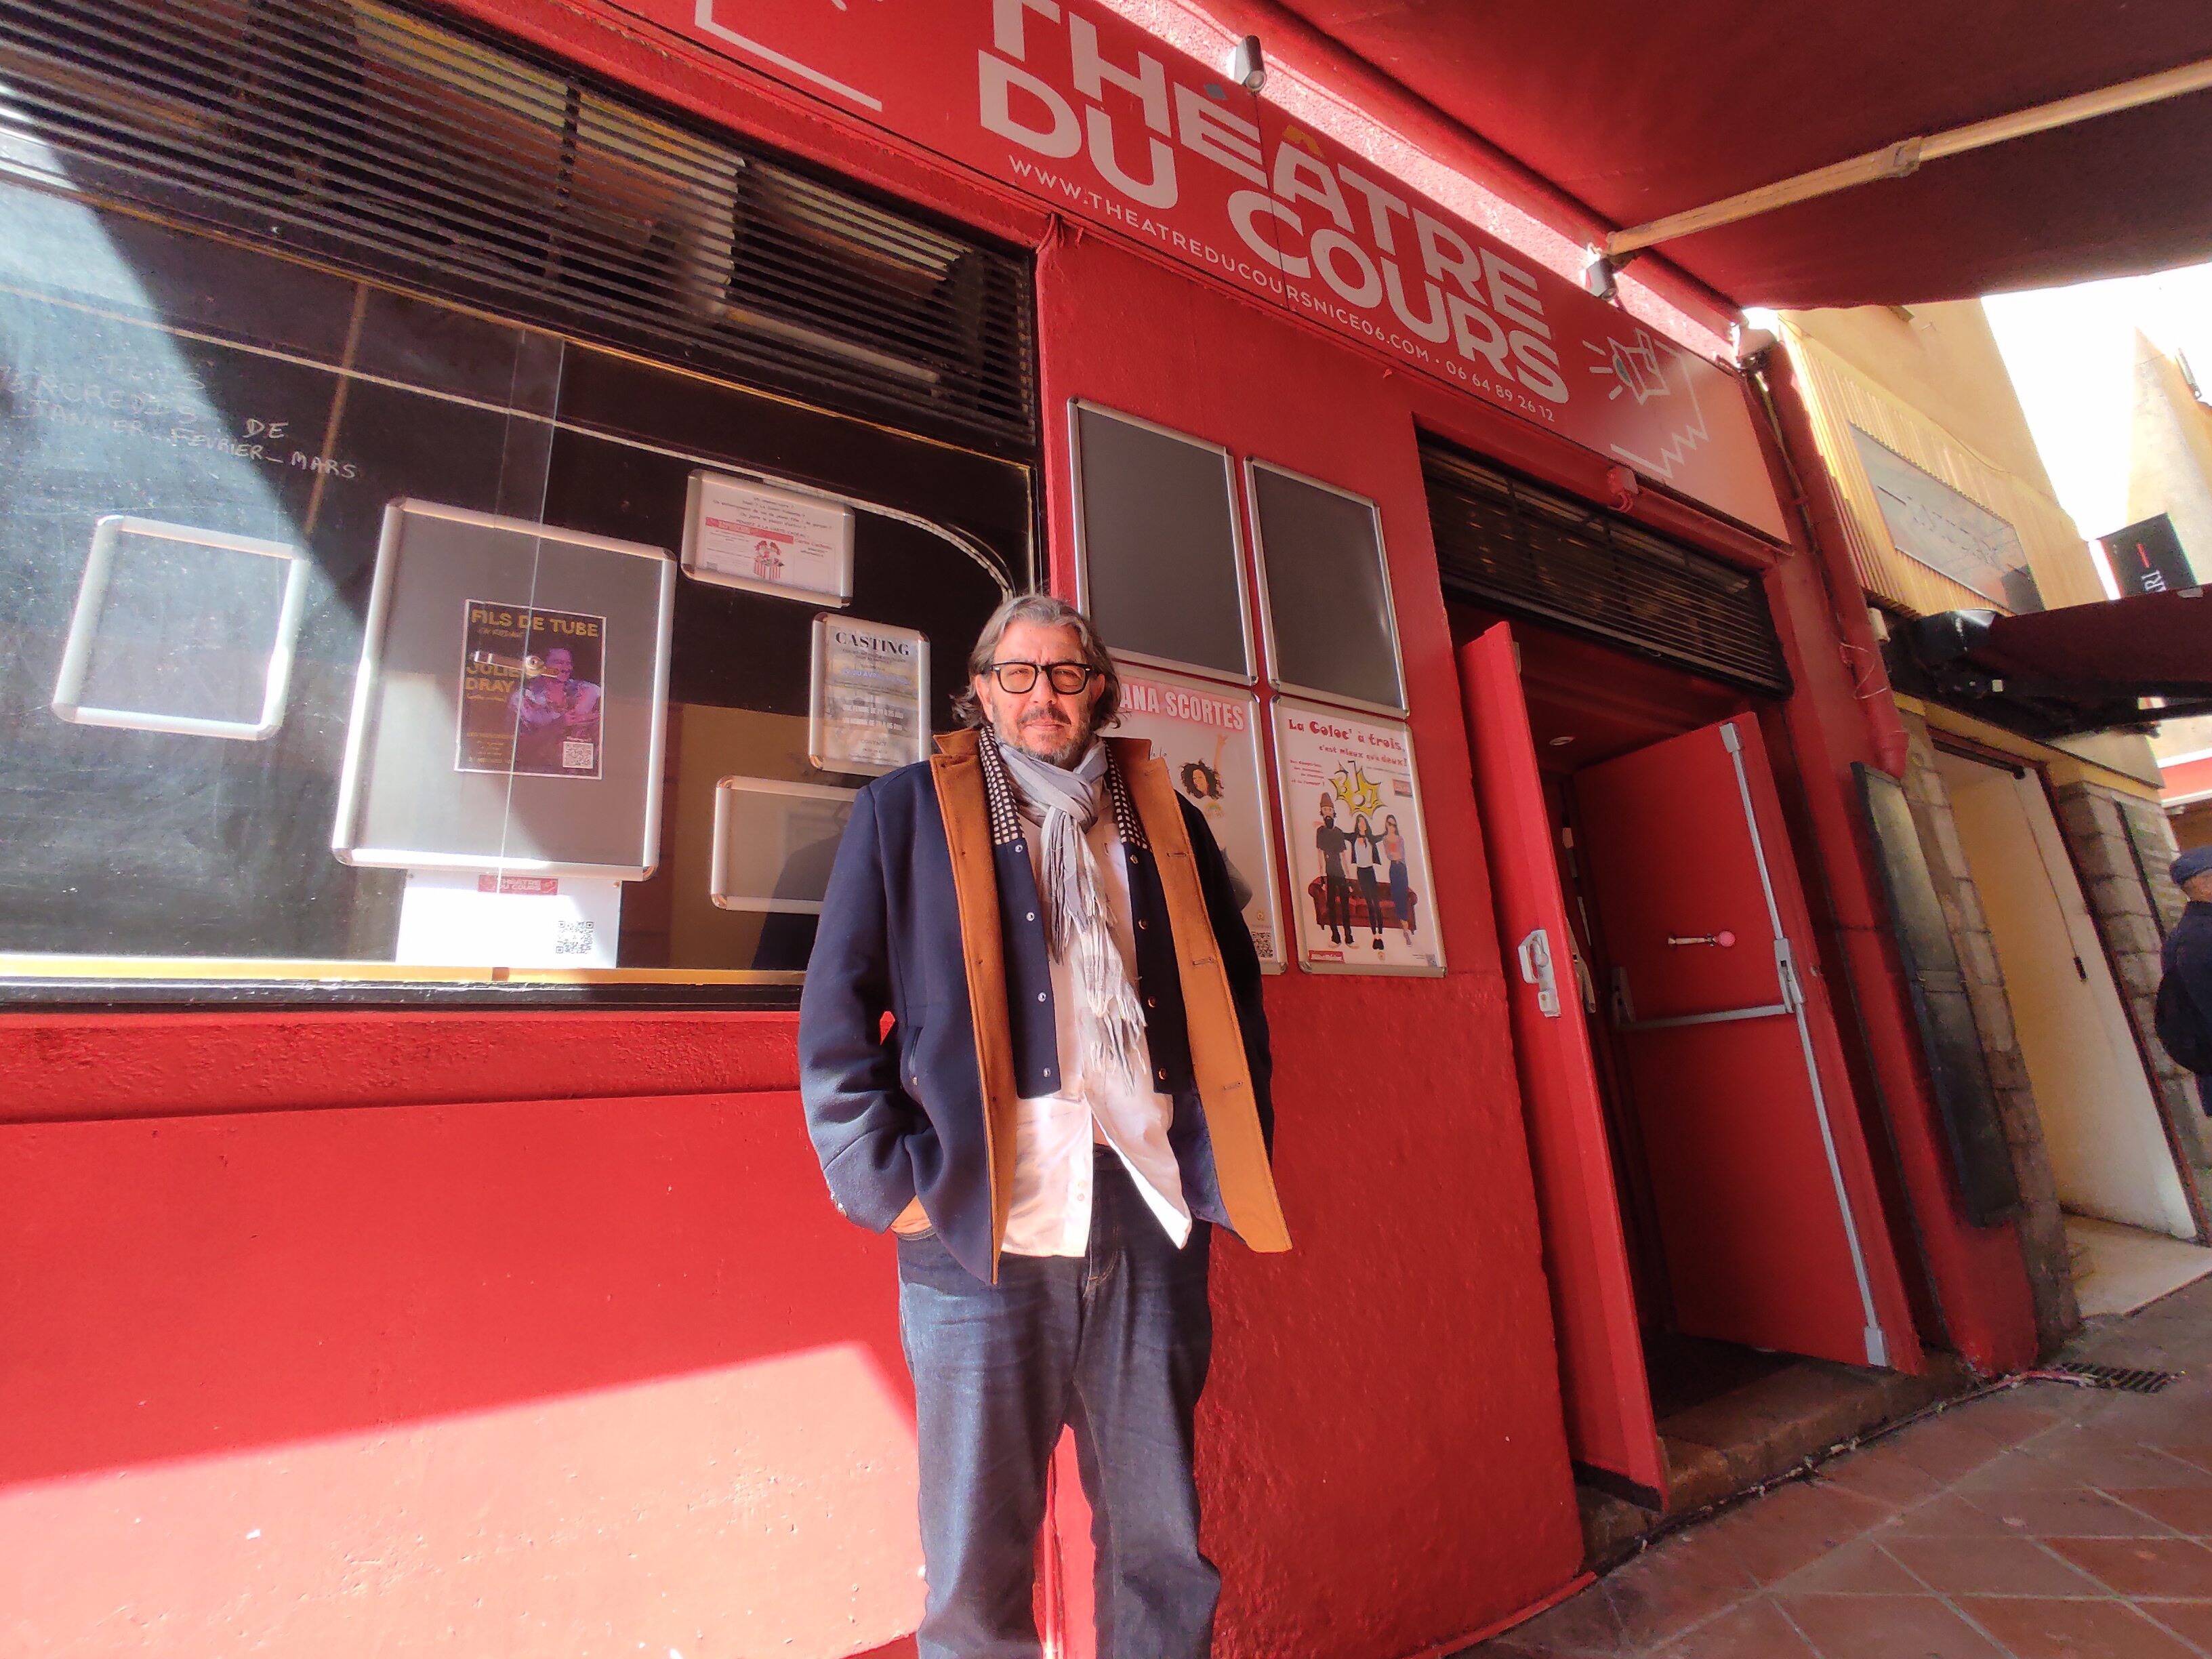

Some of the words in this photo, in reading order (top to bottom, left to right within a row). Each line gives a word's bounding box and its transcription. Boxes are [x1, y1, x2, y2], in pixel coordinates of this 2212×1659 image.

[978, 49, 1179, 209] DU
[1227, 190, 1570, 404] COURS
[1008, 154, 1430, 363] WWW.THEATREDUCOURSNICE06.COM
[1446, 361, 1467, 380] 06
[1472, 373, 1490, 392] 64
[1495, 384, 1513, 402] 89
[1517, 395, 1537, 413] 26
[241, 418, 289, 439] DE
[291, 451, 357, 478] MARS
[472, 609, 513, 628] FILS
[518, 614, 545, 631] DE
[550, 618, 598, 638] TUBE
[835, 632, 909, 656] CASTING
[1165, 691, 1244, 731] SCORTES
[1288, 718, 1305, 732] La
